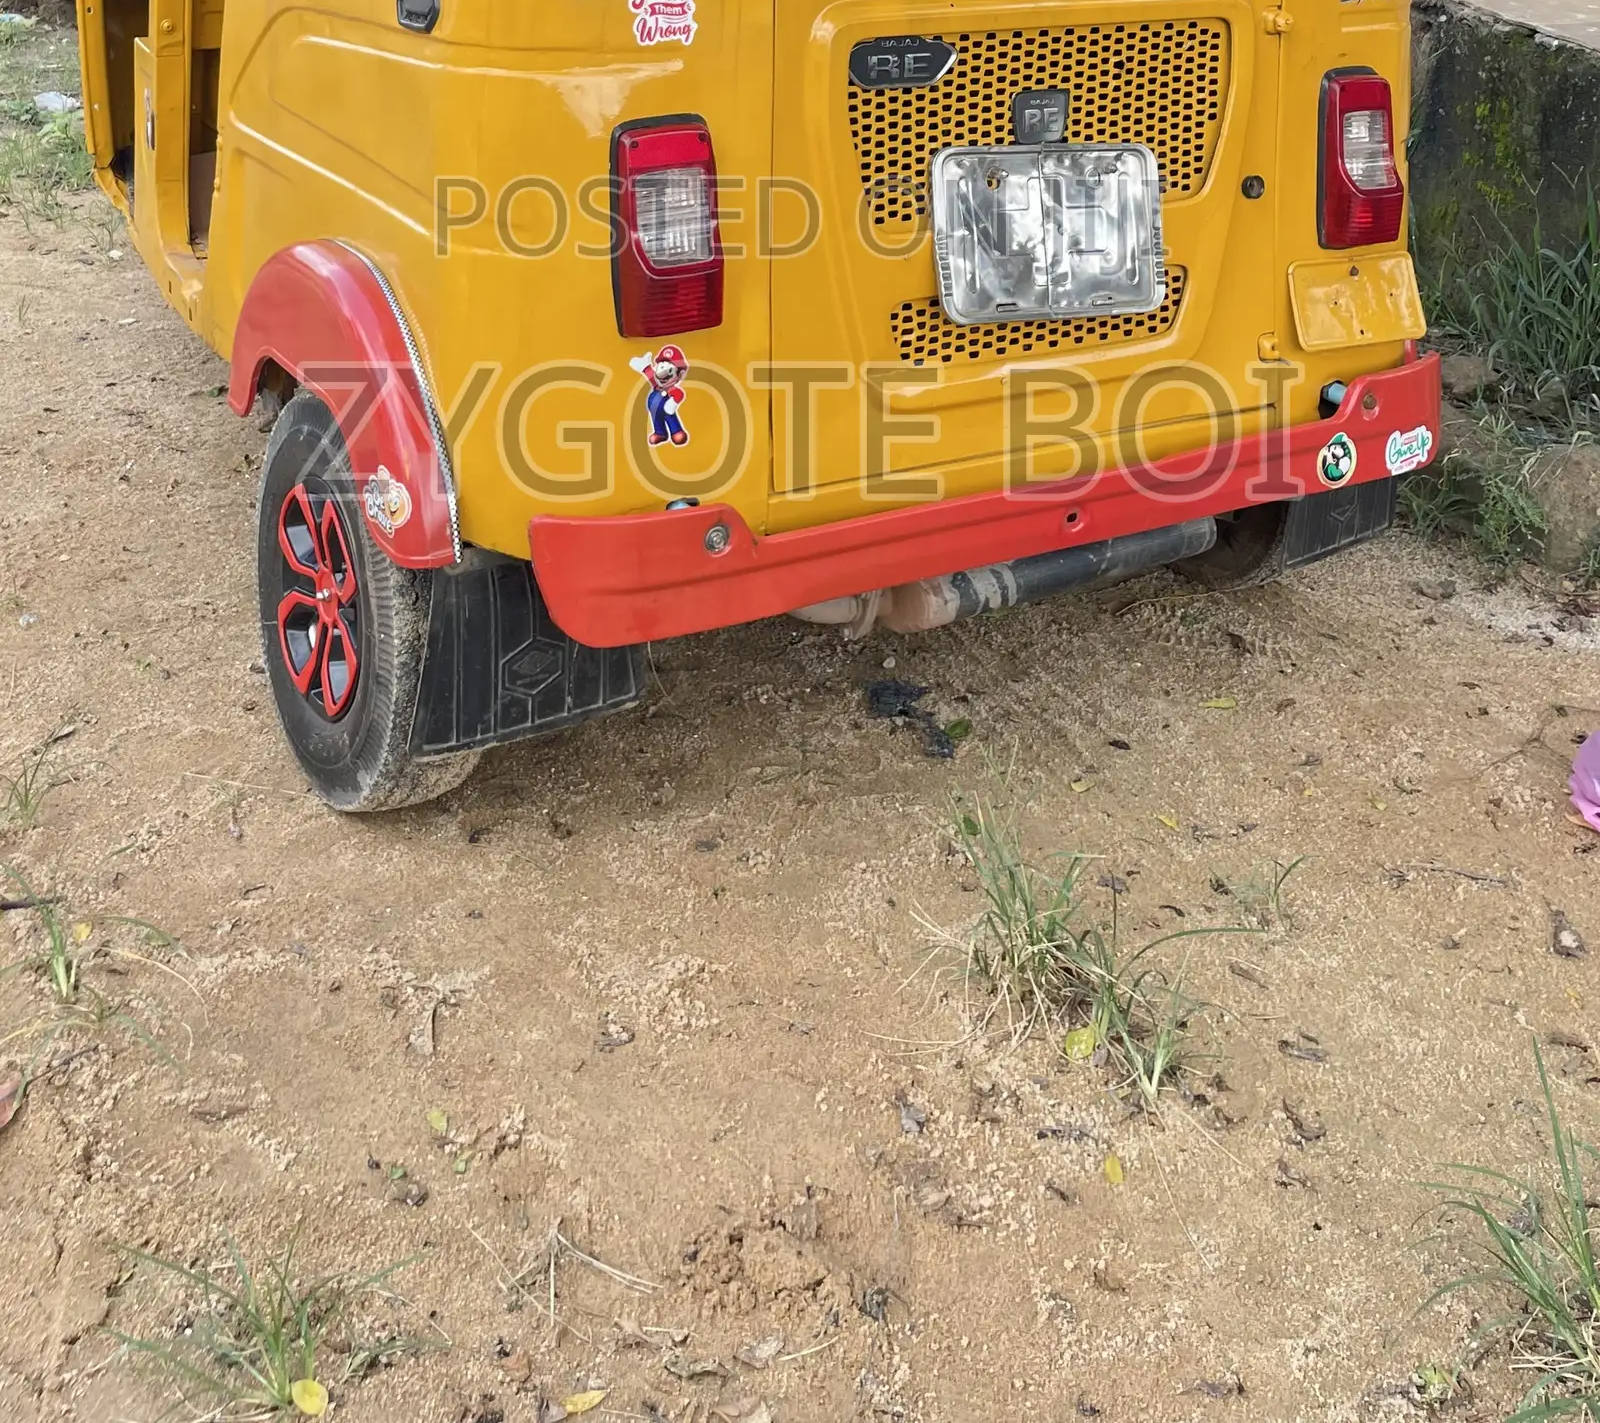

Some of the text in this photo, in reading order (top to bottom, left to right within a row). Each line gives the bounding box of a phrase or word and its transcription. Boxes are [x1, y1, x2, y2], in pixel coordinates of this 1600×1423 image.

[654, 4, 683, 16] Them
[636, 16, 693, 43] Wrong
[867, 52, 934, 80] RE
[1024, 107, 1059, 134] RE
